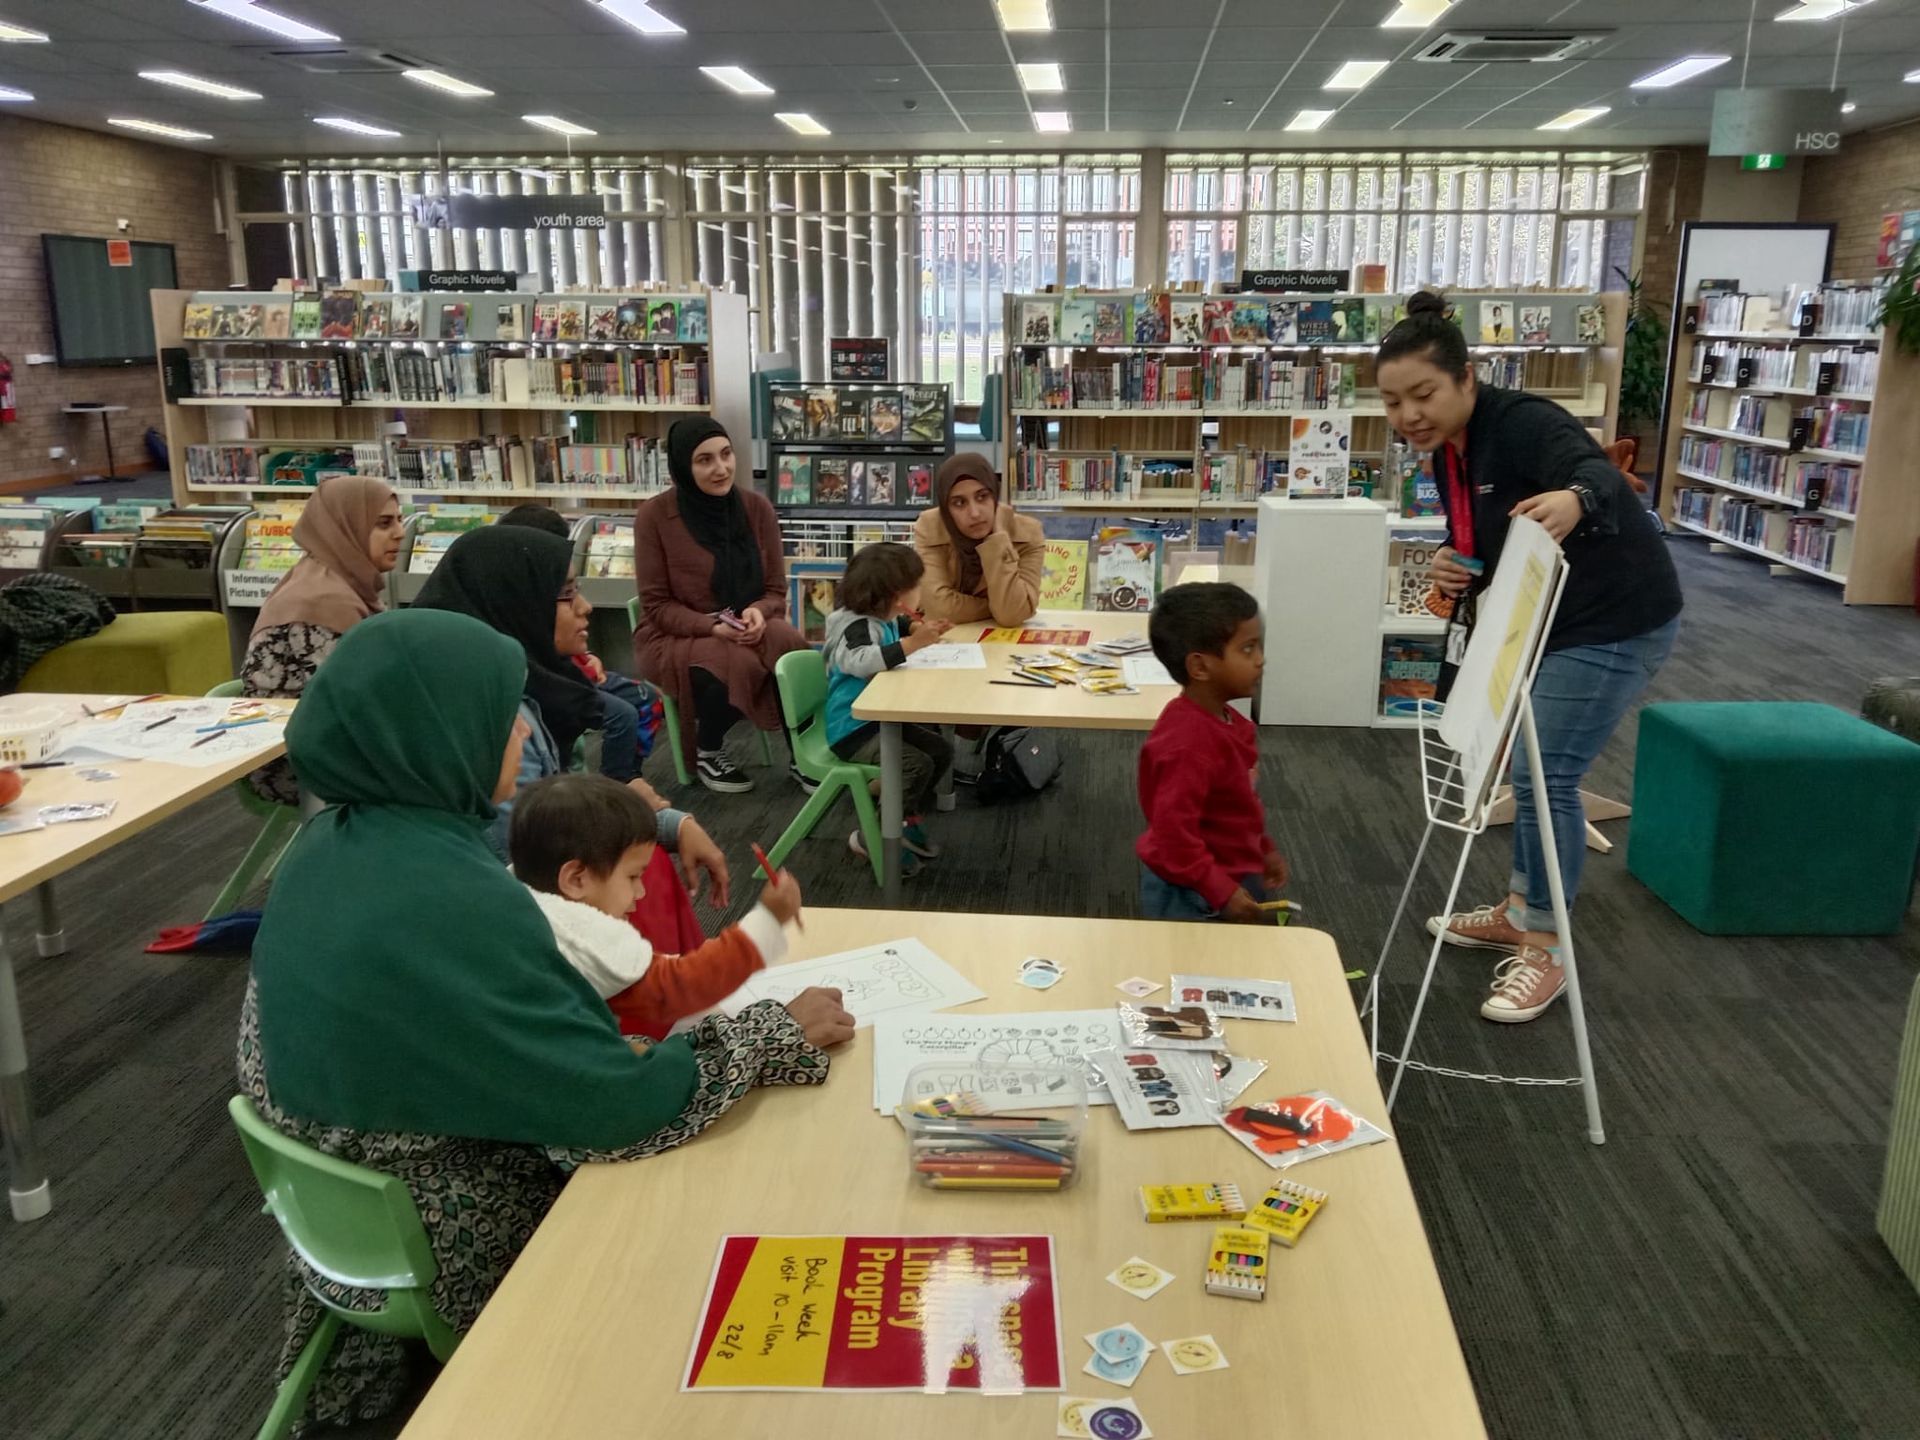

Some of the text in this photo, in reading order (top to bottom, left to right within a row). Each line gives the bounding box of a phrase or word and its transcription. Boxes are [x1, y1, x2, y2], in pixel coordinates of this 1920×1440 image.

[1795, 132, 1840, 150] HSC
[534, 213, 605, 230] youth area
[429, 274, 506, 286] Graphic Novels
[1254, 274, 1338, 287] Graphic Novels
[1686, 315, 1696, 325] A
[1803, 315, 1813, 326] D
[1703, 365, 1712, 374] B
[1739, 368, 1748, 378] C
[1820, 373, 1830, 384] E
[1793, 428, 1803, 438] F
[1808, 489, 1819, 500] G
[232, 573, 280, 584] Information
[1043, 564, 1078, 600] WHEELS
[229, 587, 259, 598] Picture
[990, 1246, 1030, 1297] Thi
[887, 1246, 940, 1331] Library
[843, 1247, 897, 1350] Program
[716, 1323, 744, 1360] 22/8
